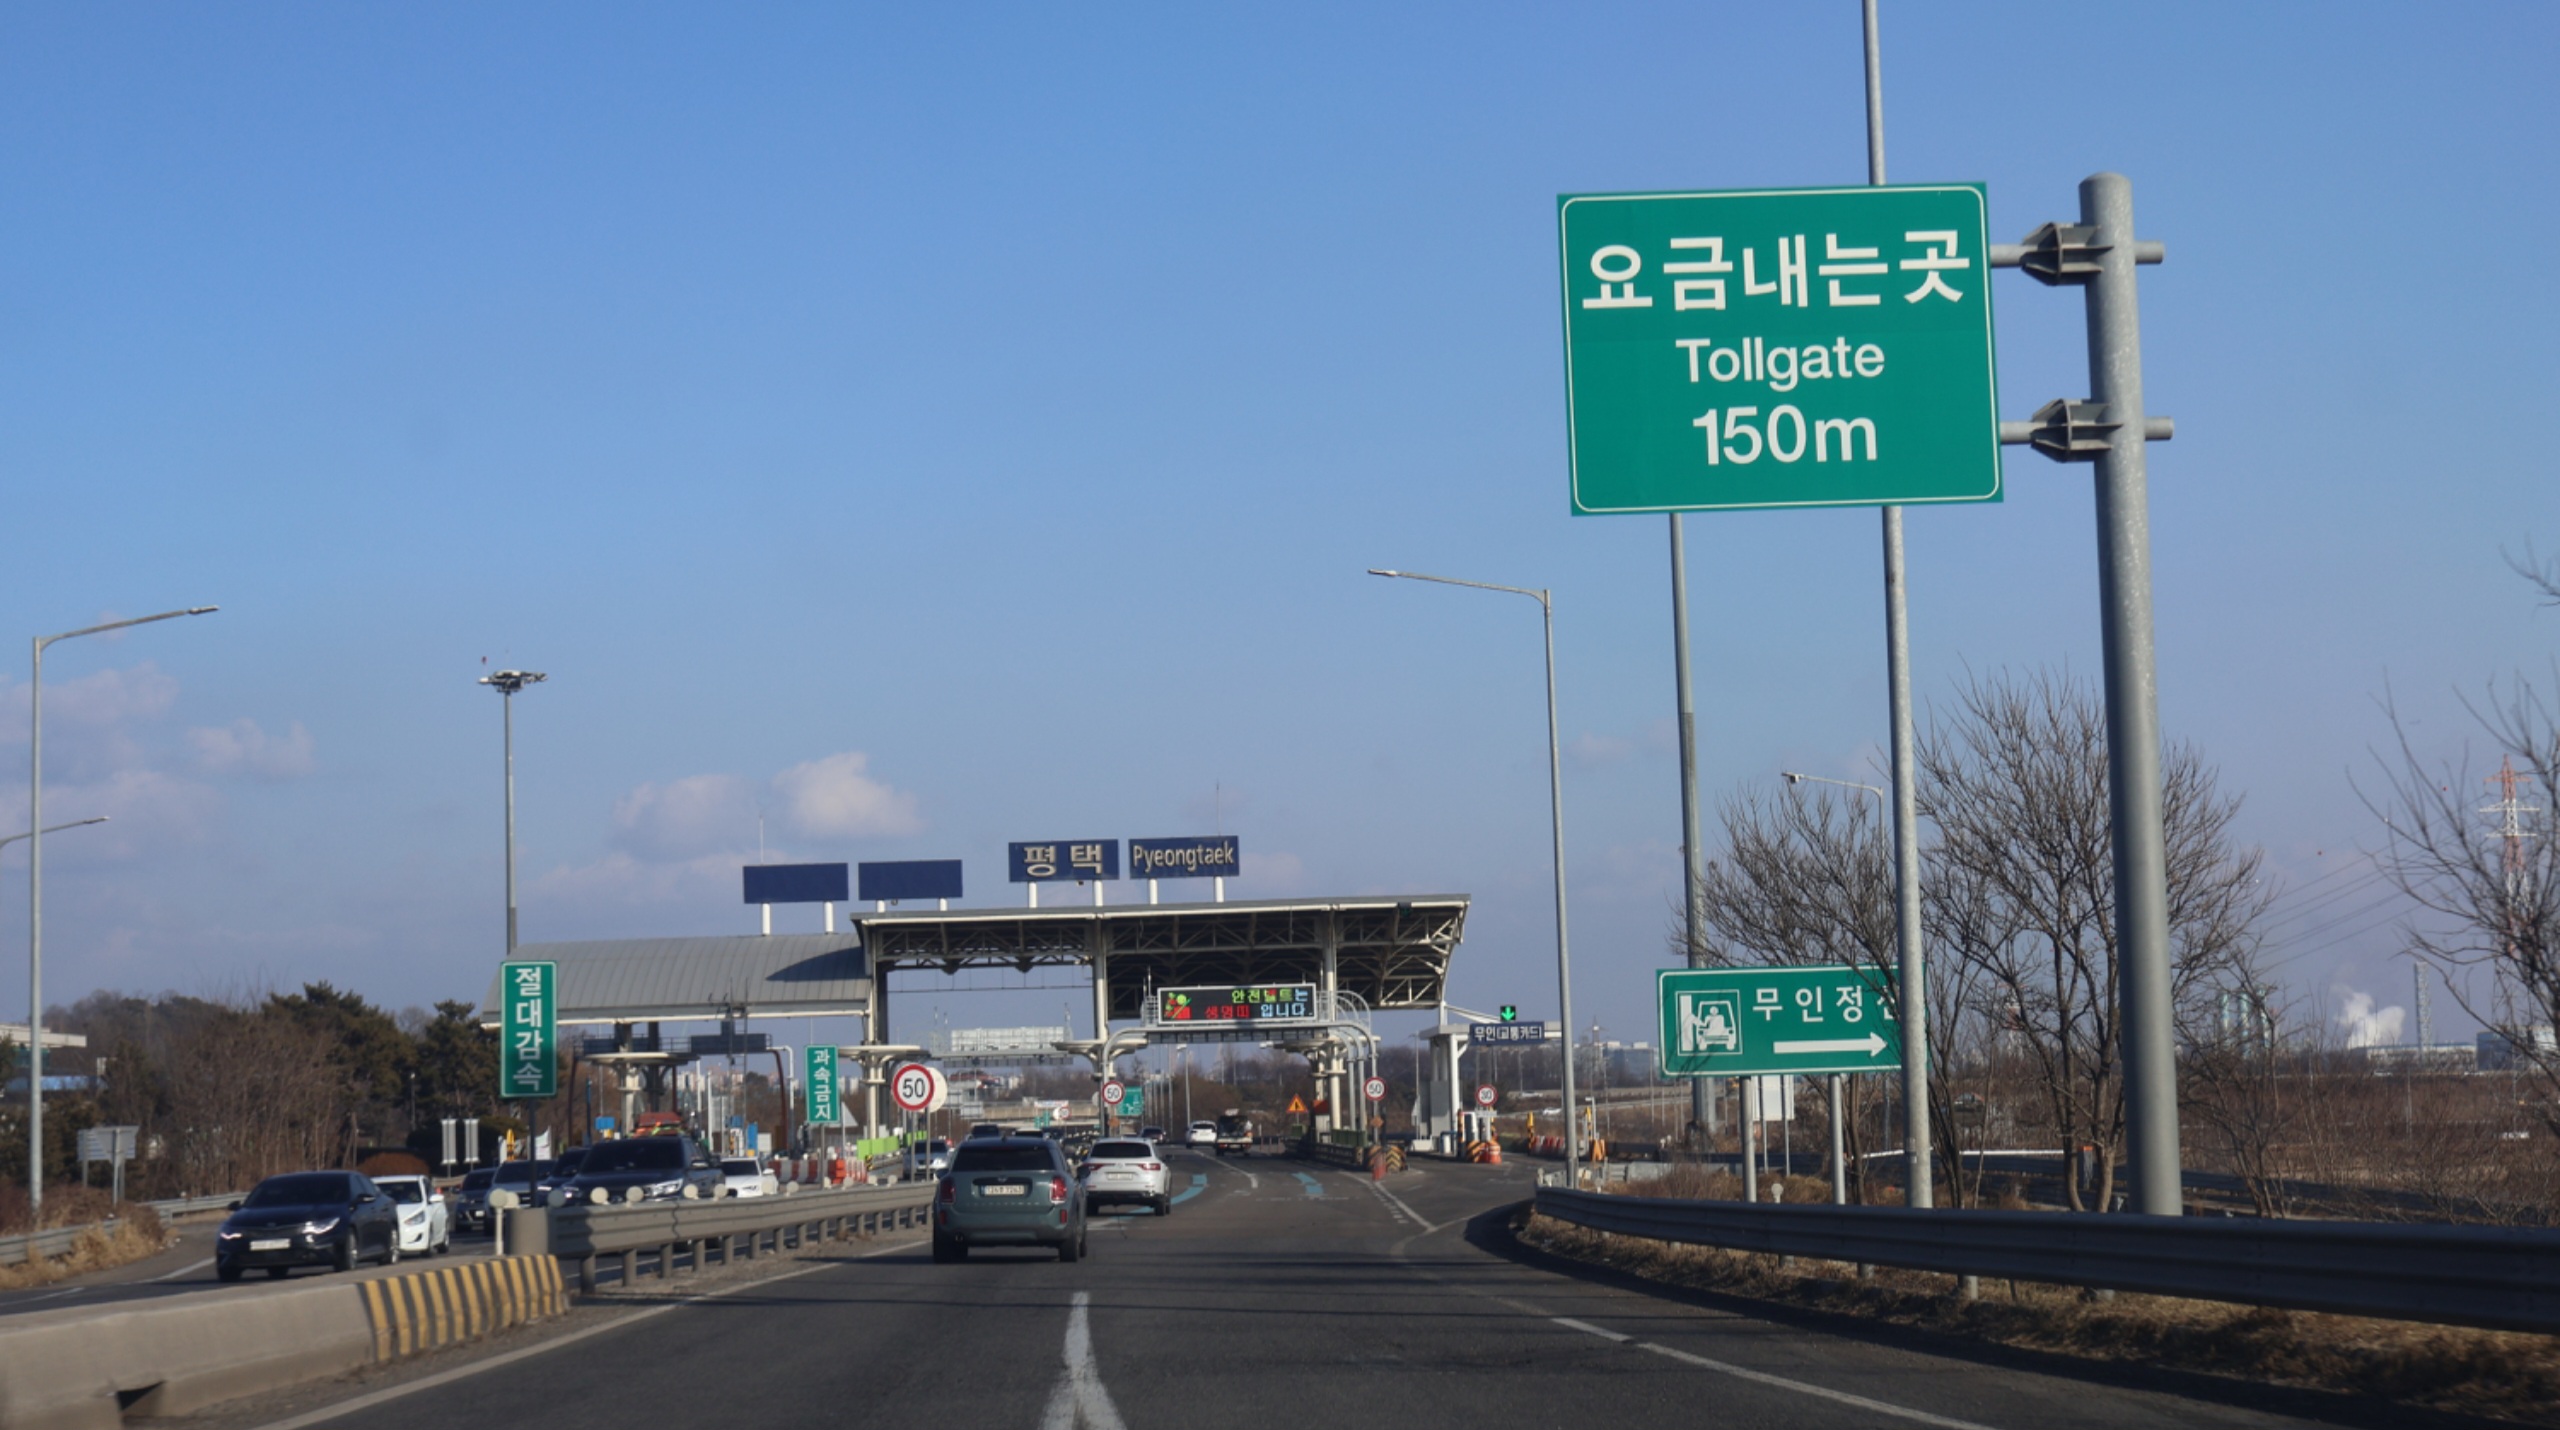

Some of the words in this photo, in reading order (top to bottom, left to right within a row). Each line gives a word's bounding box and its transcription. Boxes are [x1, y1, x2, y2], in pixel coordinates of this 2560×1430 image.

[1582, 229, 1970, 312] 요금내는곳
[1675, 336, 1885, 392] Tollgate
[1692, 404, 1878, 466] 150m
[1133, 841, 1234, 873] Pyeongtaek
[902, 1078, 926, 1099] 50
[1107, 1087, 1120, 1099] 50
[1368, 1083, 1382, 1095] 50
